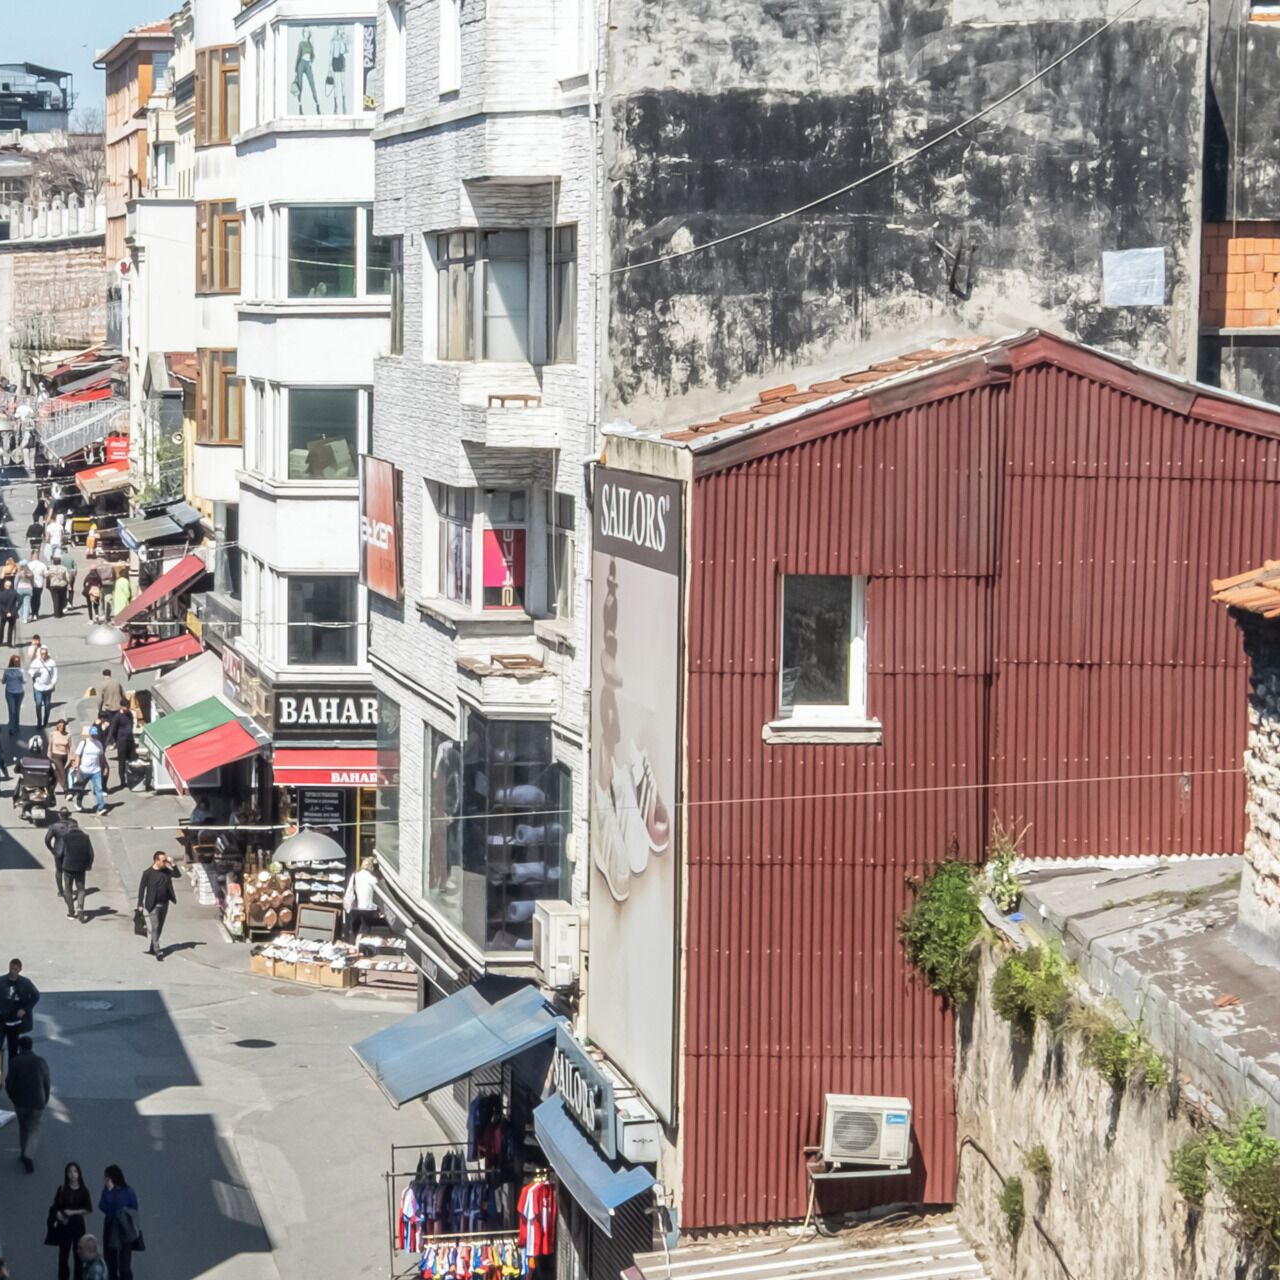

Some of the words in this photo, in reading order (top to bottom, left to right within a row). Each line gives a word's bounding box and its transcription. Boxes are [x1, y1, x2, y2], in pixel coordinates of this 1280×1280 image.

[601, 483, 667, 553] SAILORS
[280, 697, 379, 725] BAHAR
[331, 772, 378, 783] BAHAR
